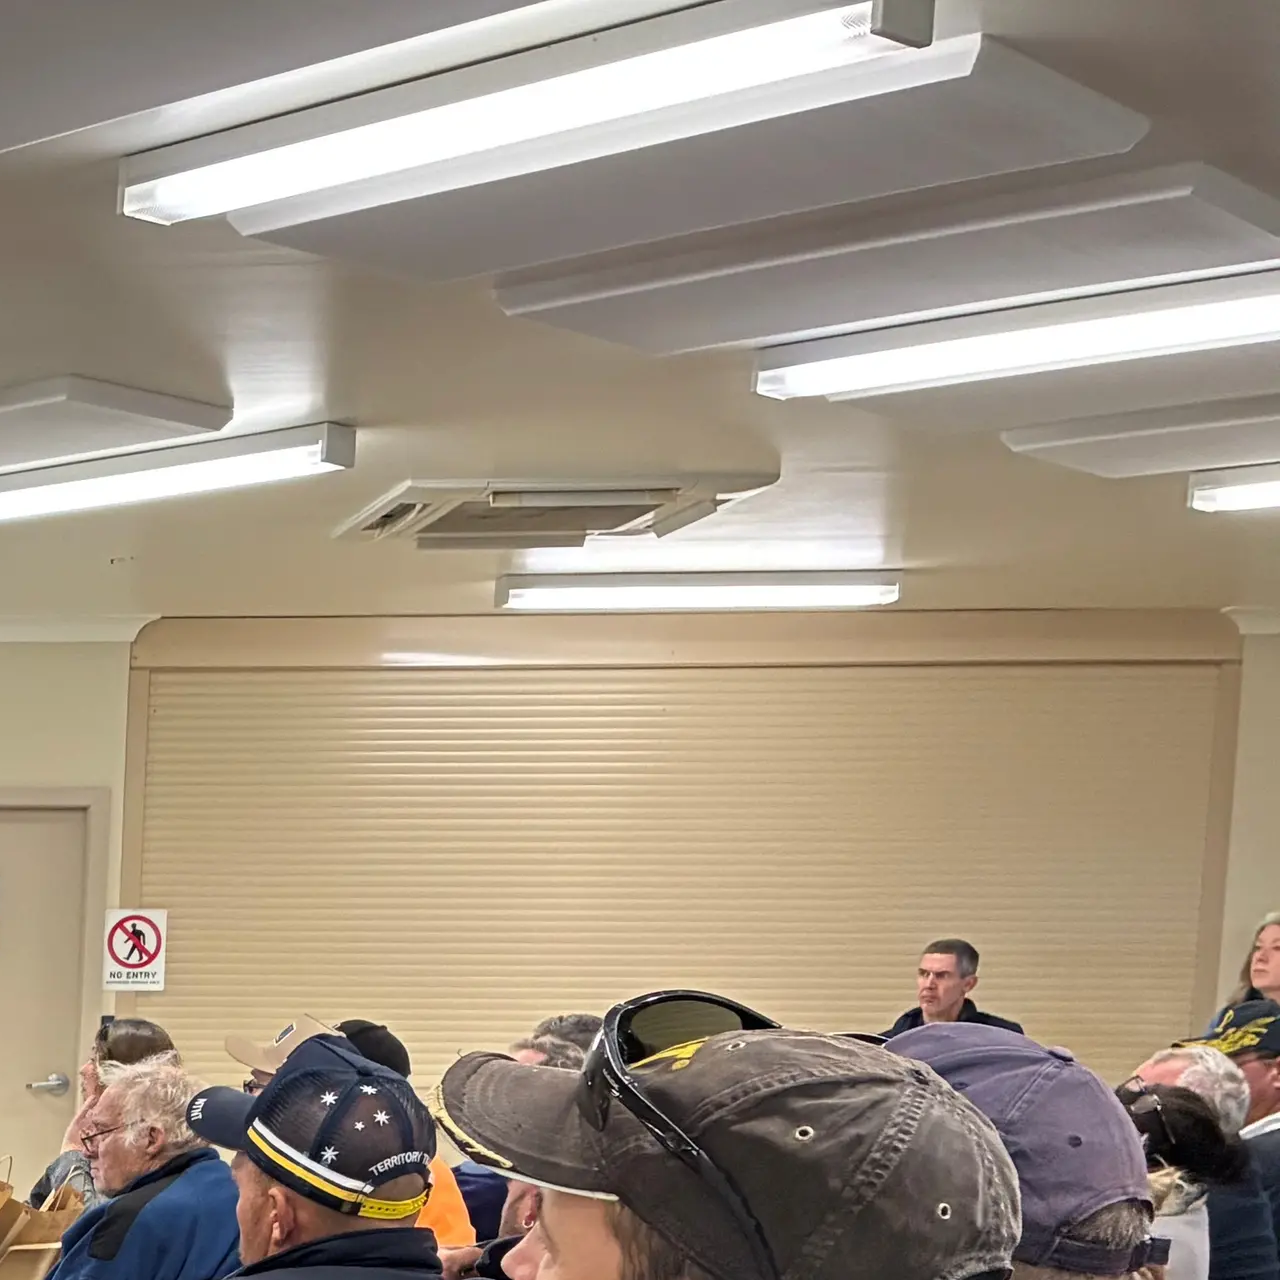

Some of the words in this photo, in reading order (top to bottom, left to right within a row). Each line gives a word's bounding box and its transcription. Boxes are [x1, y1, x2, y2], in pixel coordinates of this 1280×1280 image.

[109, 971, 123, 979] NO
[126, 971, 157, 979] ENTRY
[368, 1151, 423, 1176] TERRITORY
